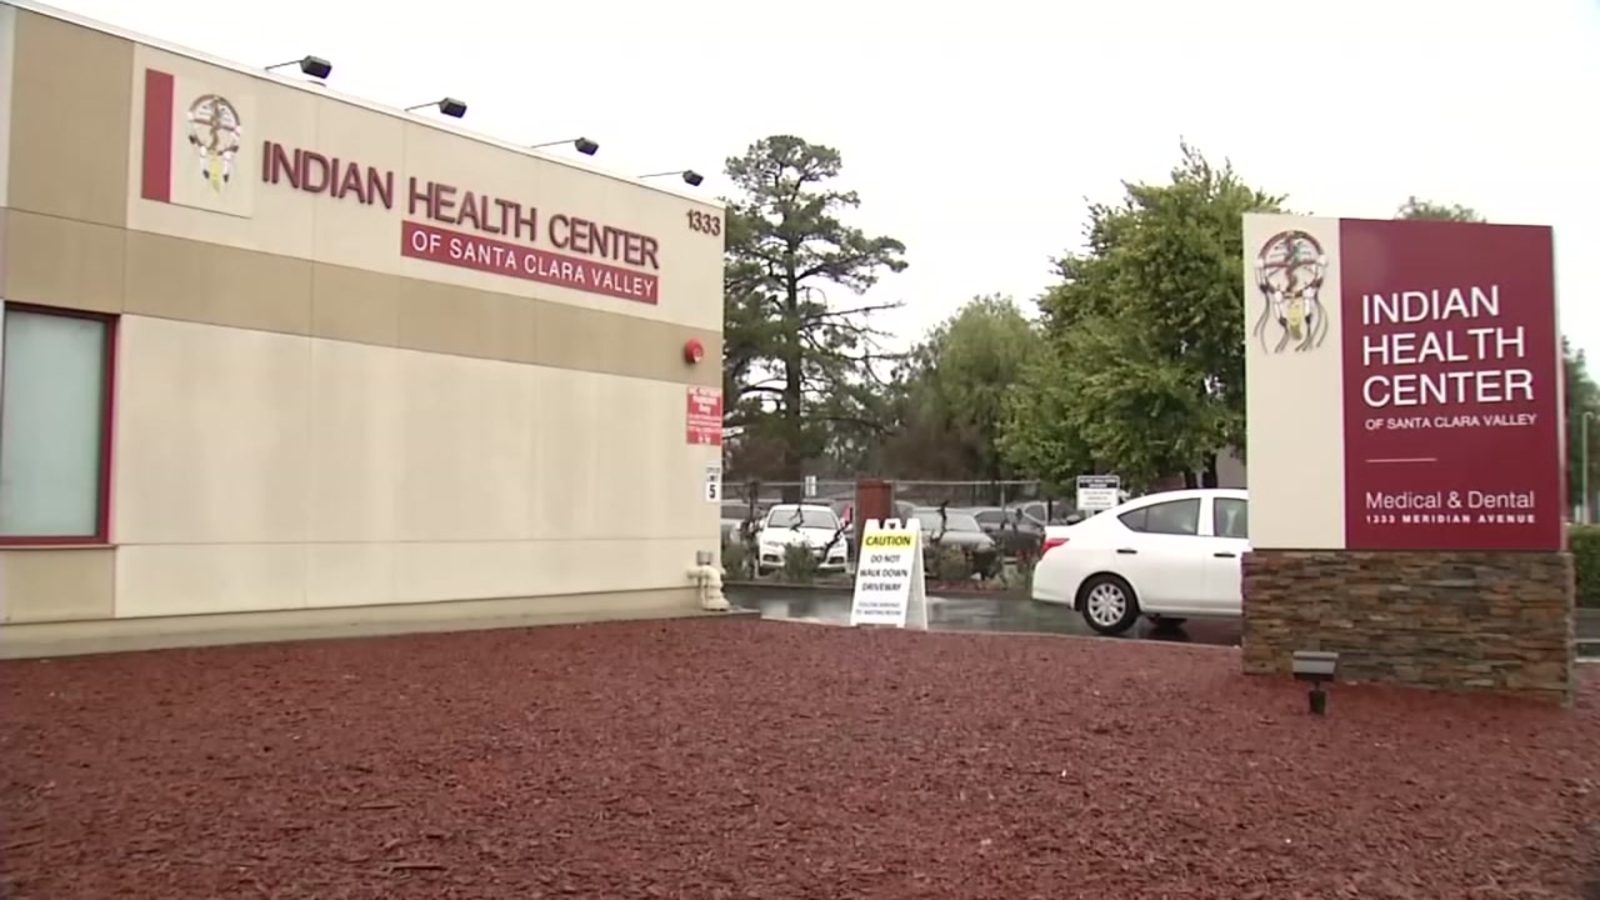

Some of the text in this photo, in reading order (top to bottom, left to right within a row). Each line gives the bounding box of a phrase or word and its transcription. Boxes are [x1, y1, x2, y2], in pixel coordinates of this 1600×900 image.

[262, 141, 660, 270] INDIAN HEALTH CENTER
[686, 209, 721, 237] 1333
[411, 230, 654, 297] OF SANTA CLARA VALLEY
[1362, 284, 1500, 326] INDIAN
[1363, 326, 1525, 366] HEALTH
[1363, 369, 1534, 408] CENTER
[1365, 412, 1537, 431] OF SANTA CLARA VALLEY
[709, 484, 716, 499] 5
[1365, 490, 1535, 510] Medical & Dental
[1365, 513, 1536, 525] 1333 MERIDIAN AVENUE
[865, 536, 911, 546] CAUTION
[870, 554, 901, 564] DO NOT
[860, 568, 908, 578] WALK DOWN
[862, 583, 902, 591] DRIVEWAY
